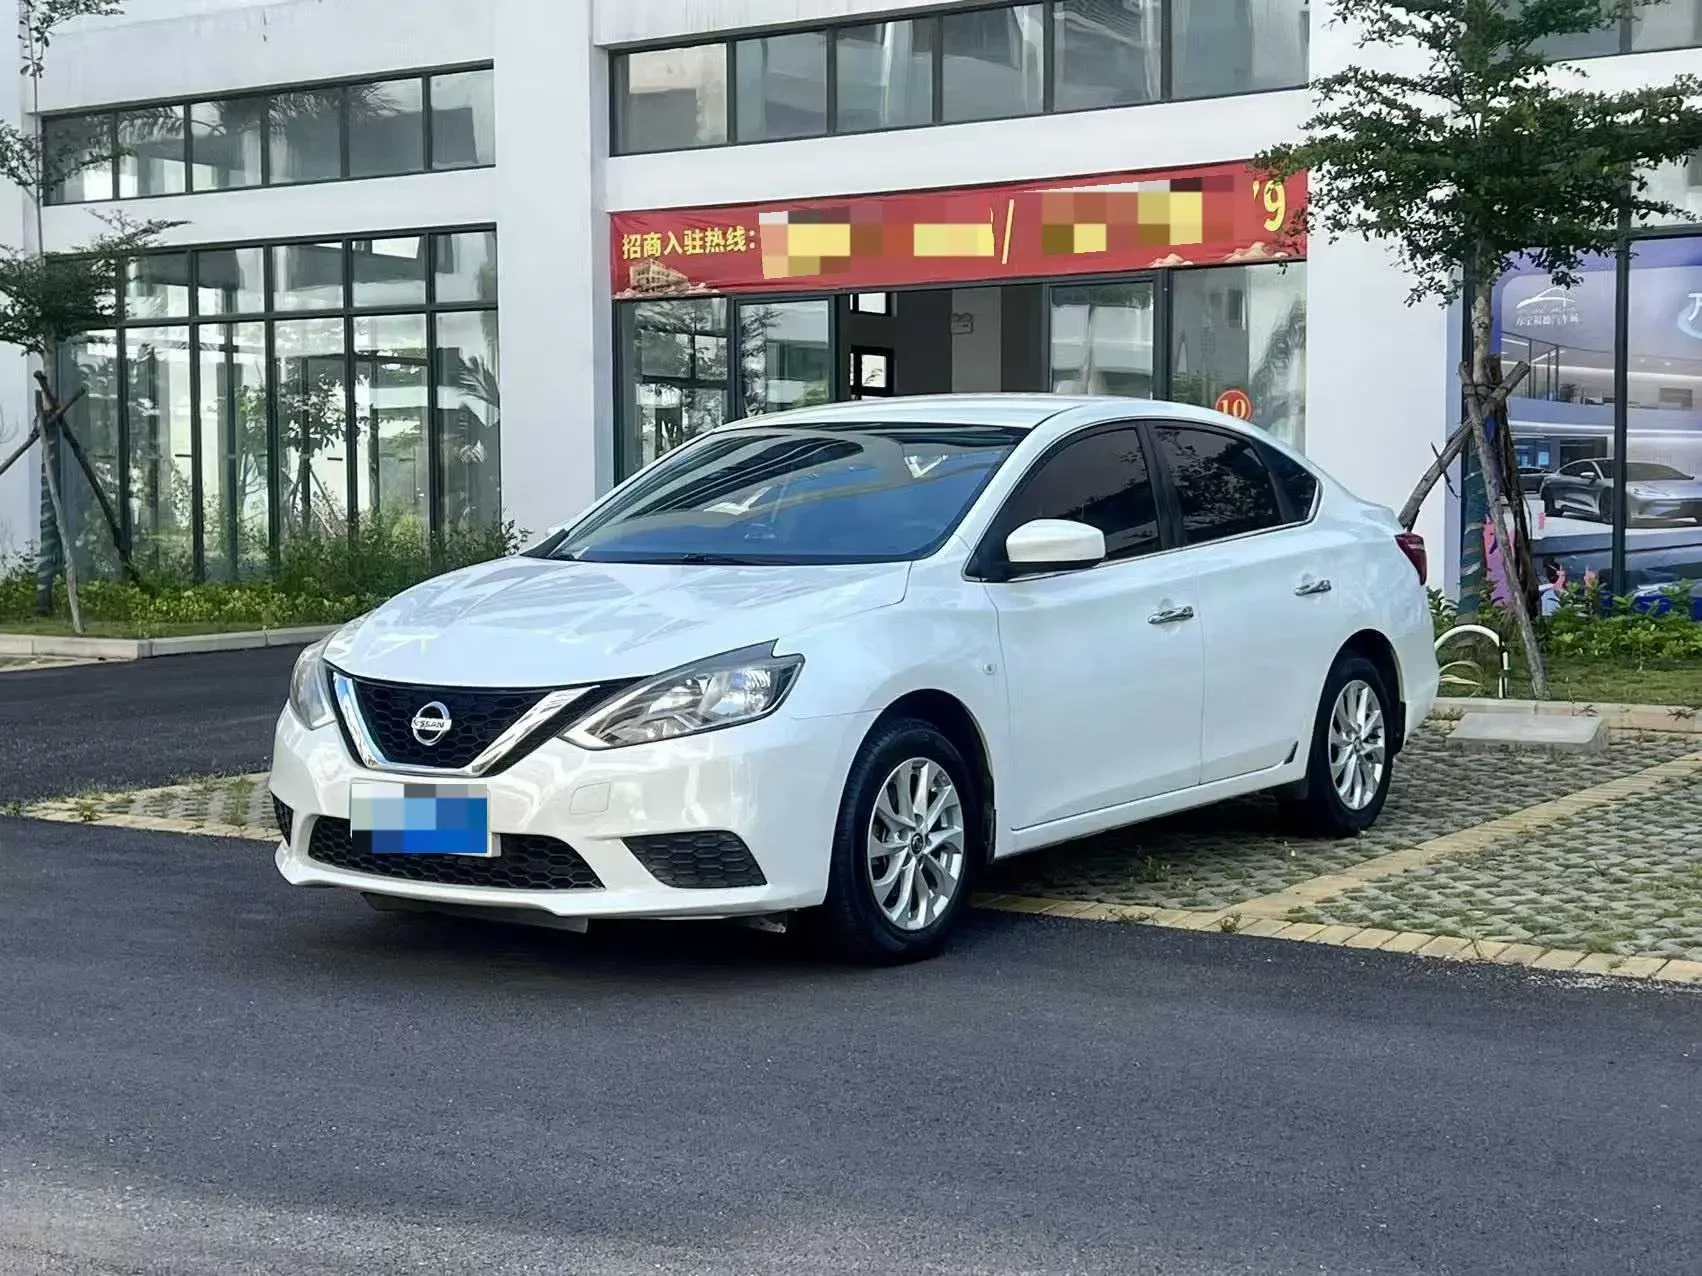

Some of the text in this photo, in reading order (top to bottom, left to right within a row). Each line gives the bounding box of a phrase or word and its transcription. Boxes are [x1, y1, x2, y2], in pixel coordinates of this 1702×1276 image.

[622, 225, 756, 260] 招商入驻热线：
[1221, 399, 1247, 418] 10
